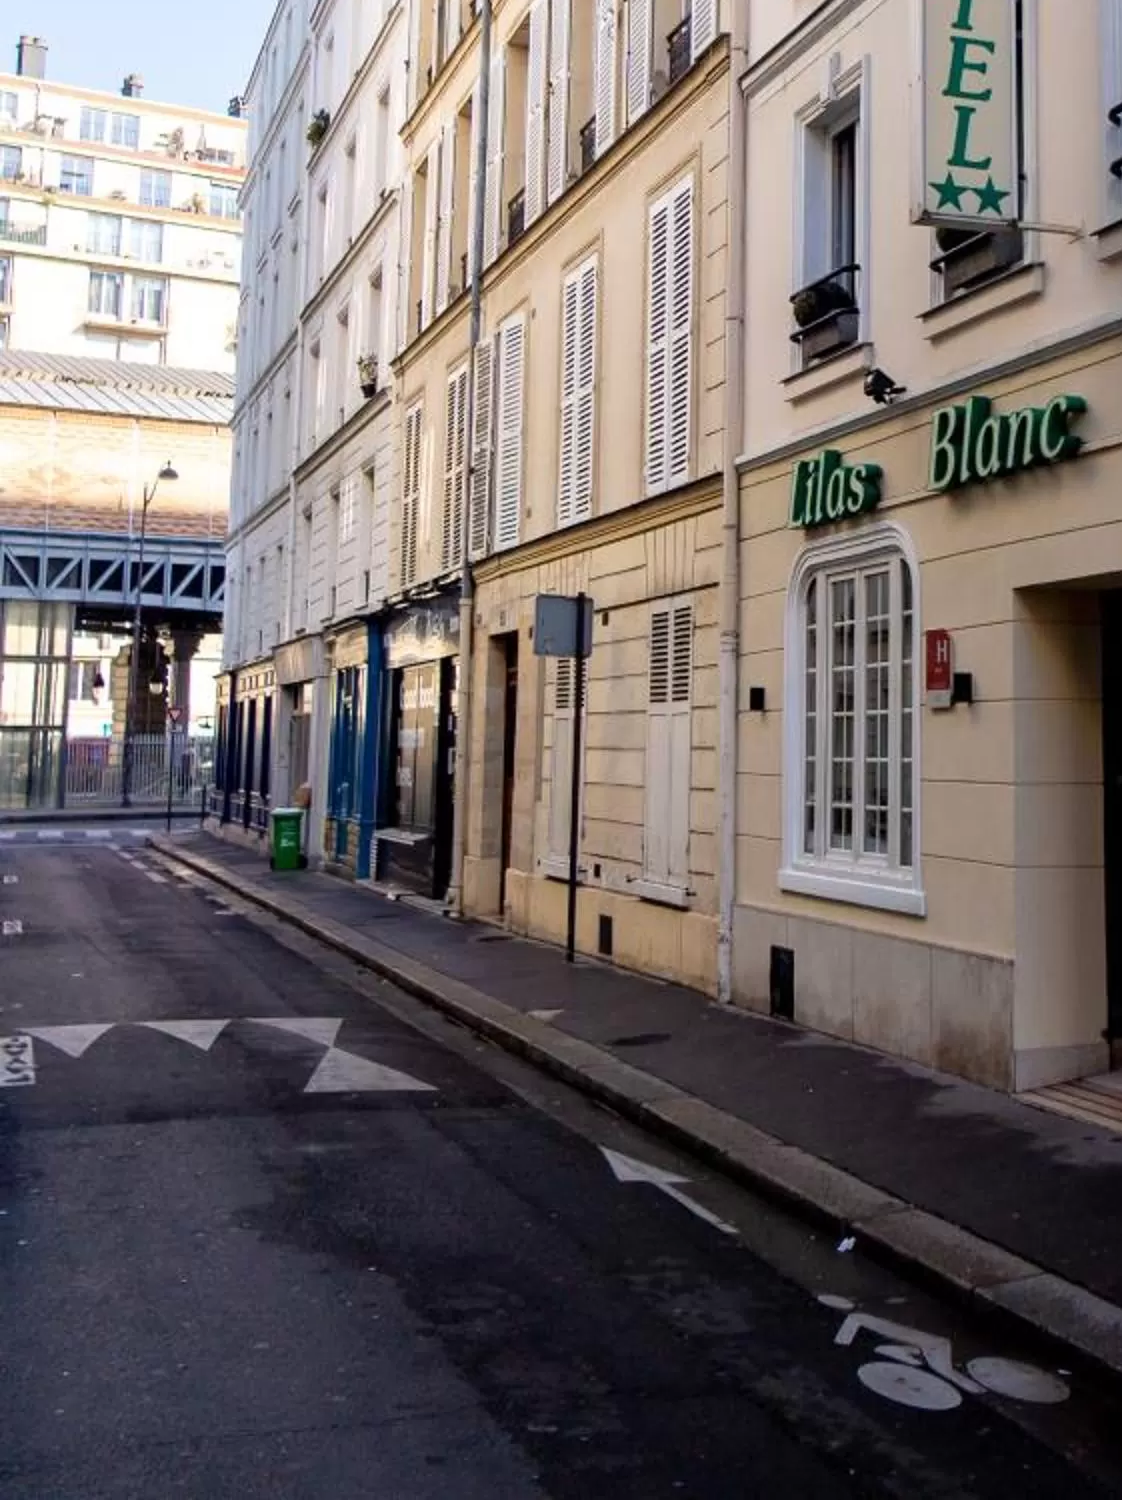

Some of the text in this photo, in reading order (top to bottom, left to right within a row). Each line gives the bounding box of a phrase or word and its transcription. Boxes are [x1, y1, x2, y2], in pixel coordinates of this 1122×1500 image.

[788, 450, 881, 529] Lilas
[926, 394, 1087, 492] Blanc
[935, 639, 948, 664] H
